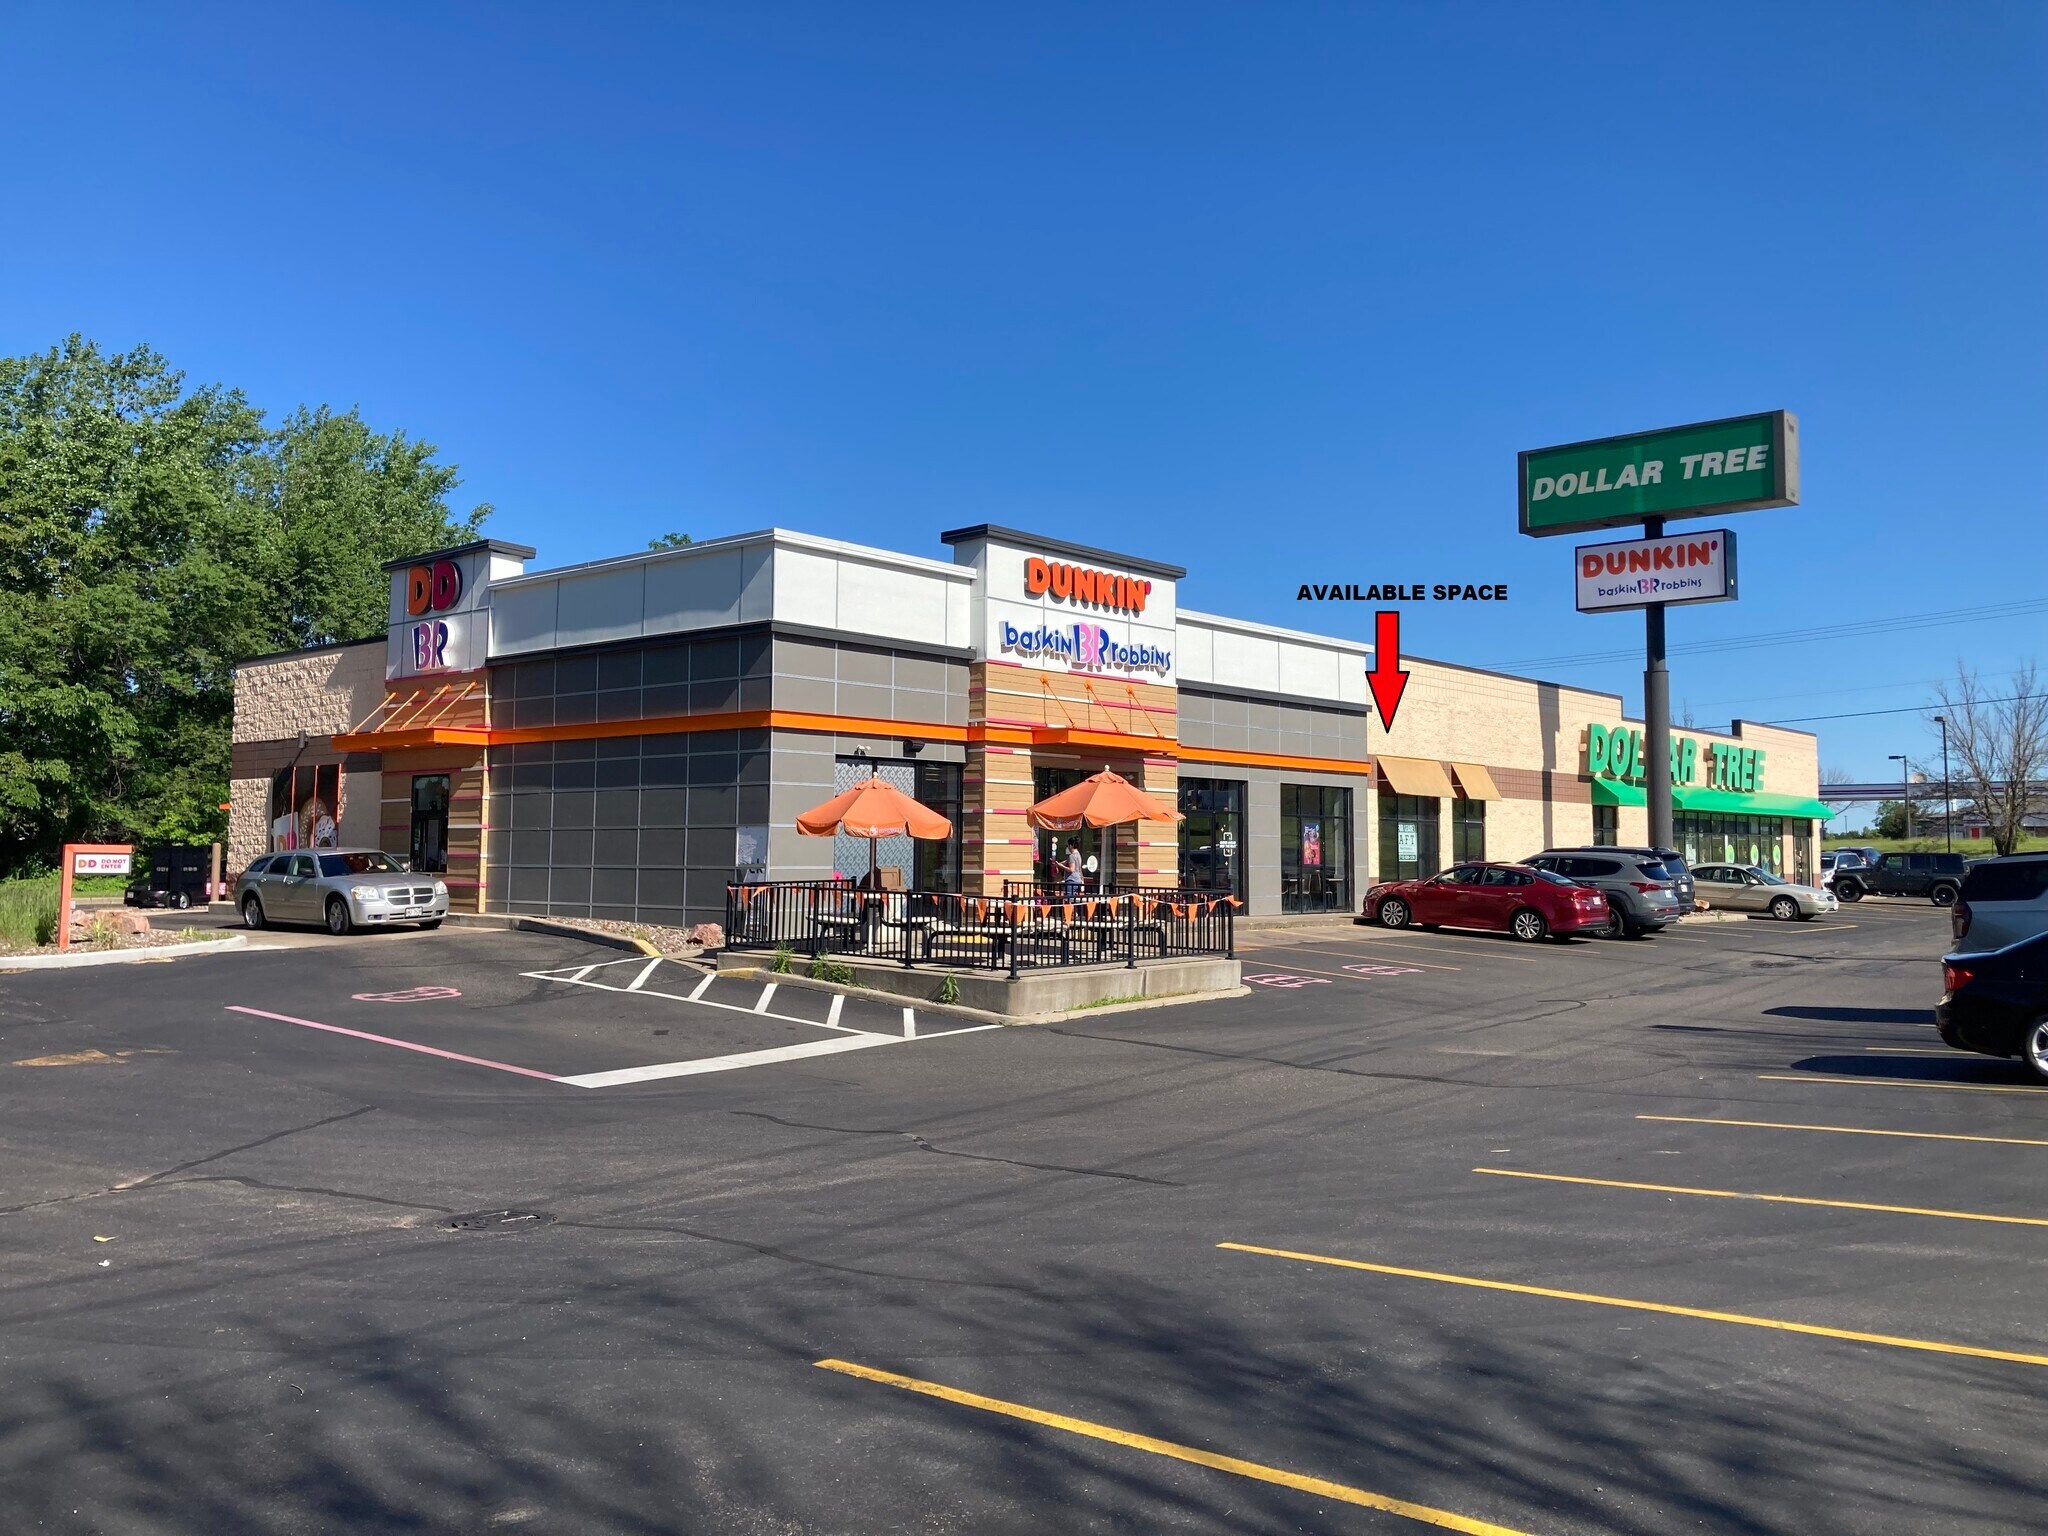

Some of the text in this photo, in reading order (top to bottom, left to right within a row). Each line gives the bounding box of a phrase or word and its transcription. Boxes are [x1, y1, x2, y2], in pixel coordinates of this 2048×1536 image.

[1532, 444, 1770, 502] DOLLAR TREE
[1024, 557, 1152, 612] DUNKIN'
[1583, 540, 1718, 578] DUNKIN'
[407, 560, 463, 616] DD
[1598, 584, 1637, 597] baskin
[1661, 578, 1702, 591] robbins
[412, 620, 451, 671] BR
[1003, 621, 1073, 656] baskin
[1110, 642, 1172, 672] robbins
[1587, 722, 1767, 791] DOLAR TREE
